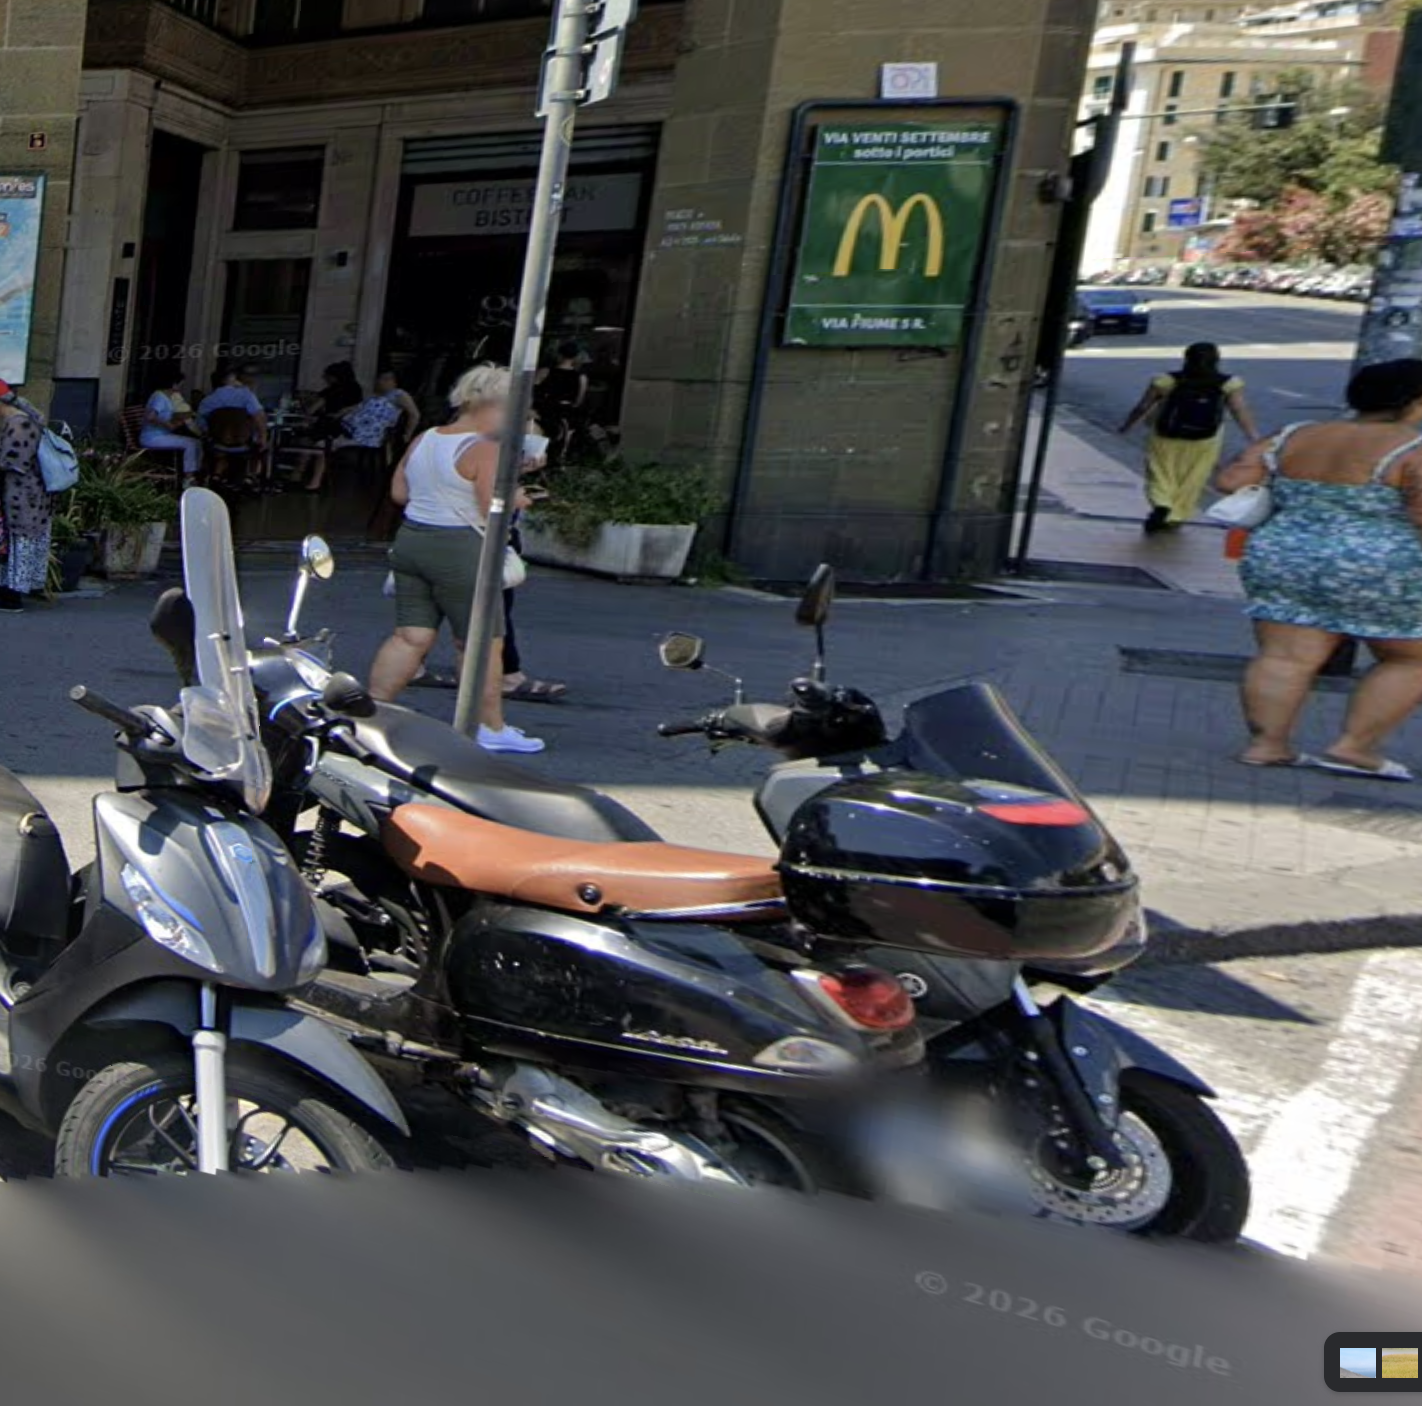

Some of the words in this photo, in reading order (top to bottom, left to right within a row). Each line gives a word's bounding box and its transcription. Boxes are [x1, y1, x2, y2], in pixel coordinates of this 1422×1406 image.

[823, 132, 848, 144] VIA
[852, 132, 897, 144] VENTI
[901, 131, 990, 144] SETTEMBRE
[854, 146, 894, 159] sotto
[896, 146, 902, 158] i
[903, 146, 955, 160] portici
[474, 207, 572, 227] BISTT
[822, 318, 848, 328] VIA
